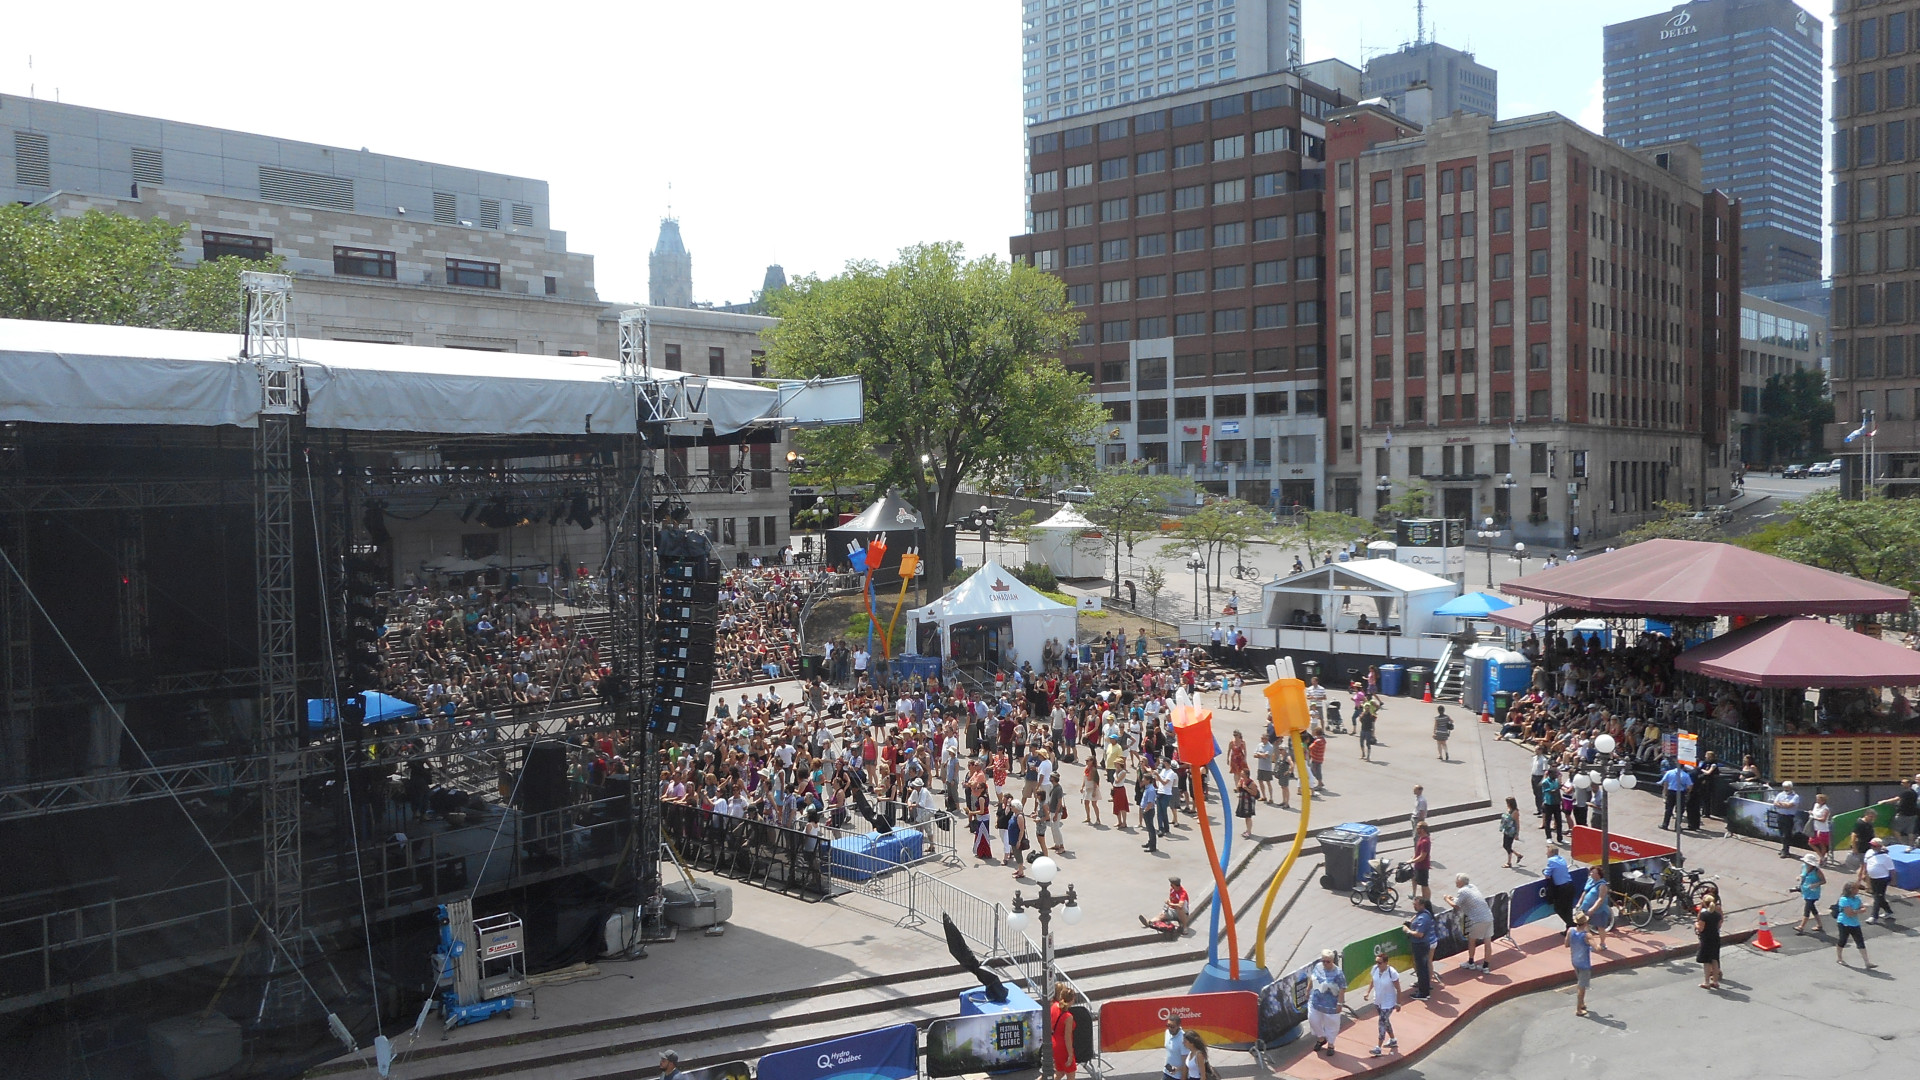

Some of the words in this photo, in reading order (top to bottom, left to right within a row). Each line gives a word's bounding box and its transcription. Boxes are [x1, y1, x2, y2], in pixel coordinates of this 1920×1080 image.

[1660, 25, 1697, 40] DELTA
[989, 593, 1019, 601] CANADIAN
[488, 942, 516, 952] SIMPLEX
[1000, 1024, 1020, 1033] FESTIVAL
[831, 1051, 850, 1060] Hydro
[838, 1054, 862, 1065] Québec
